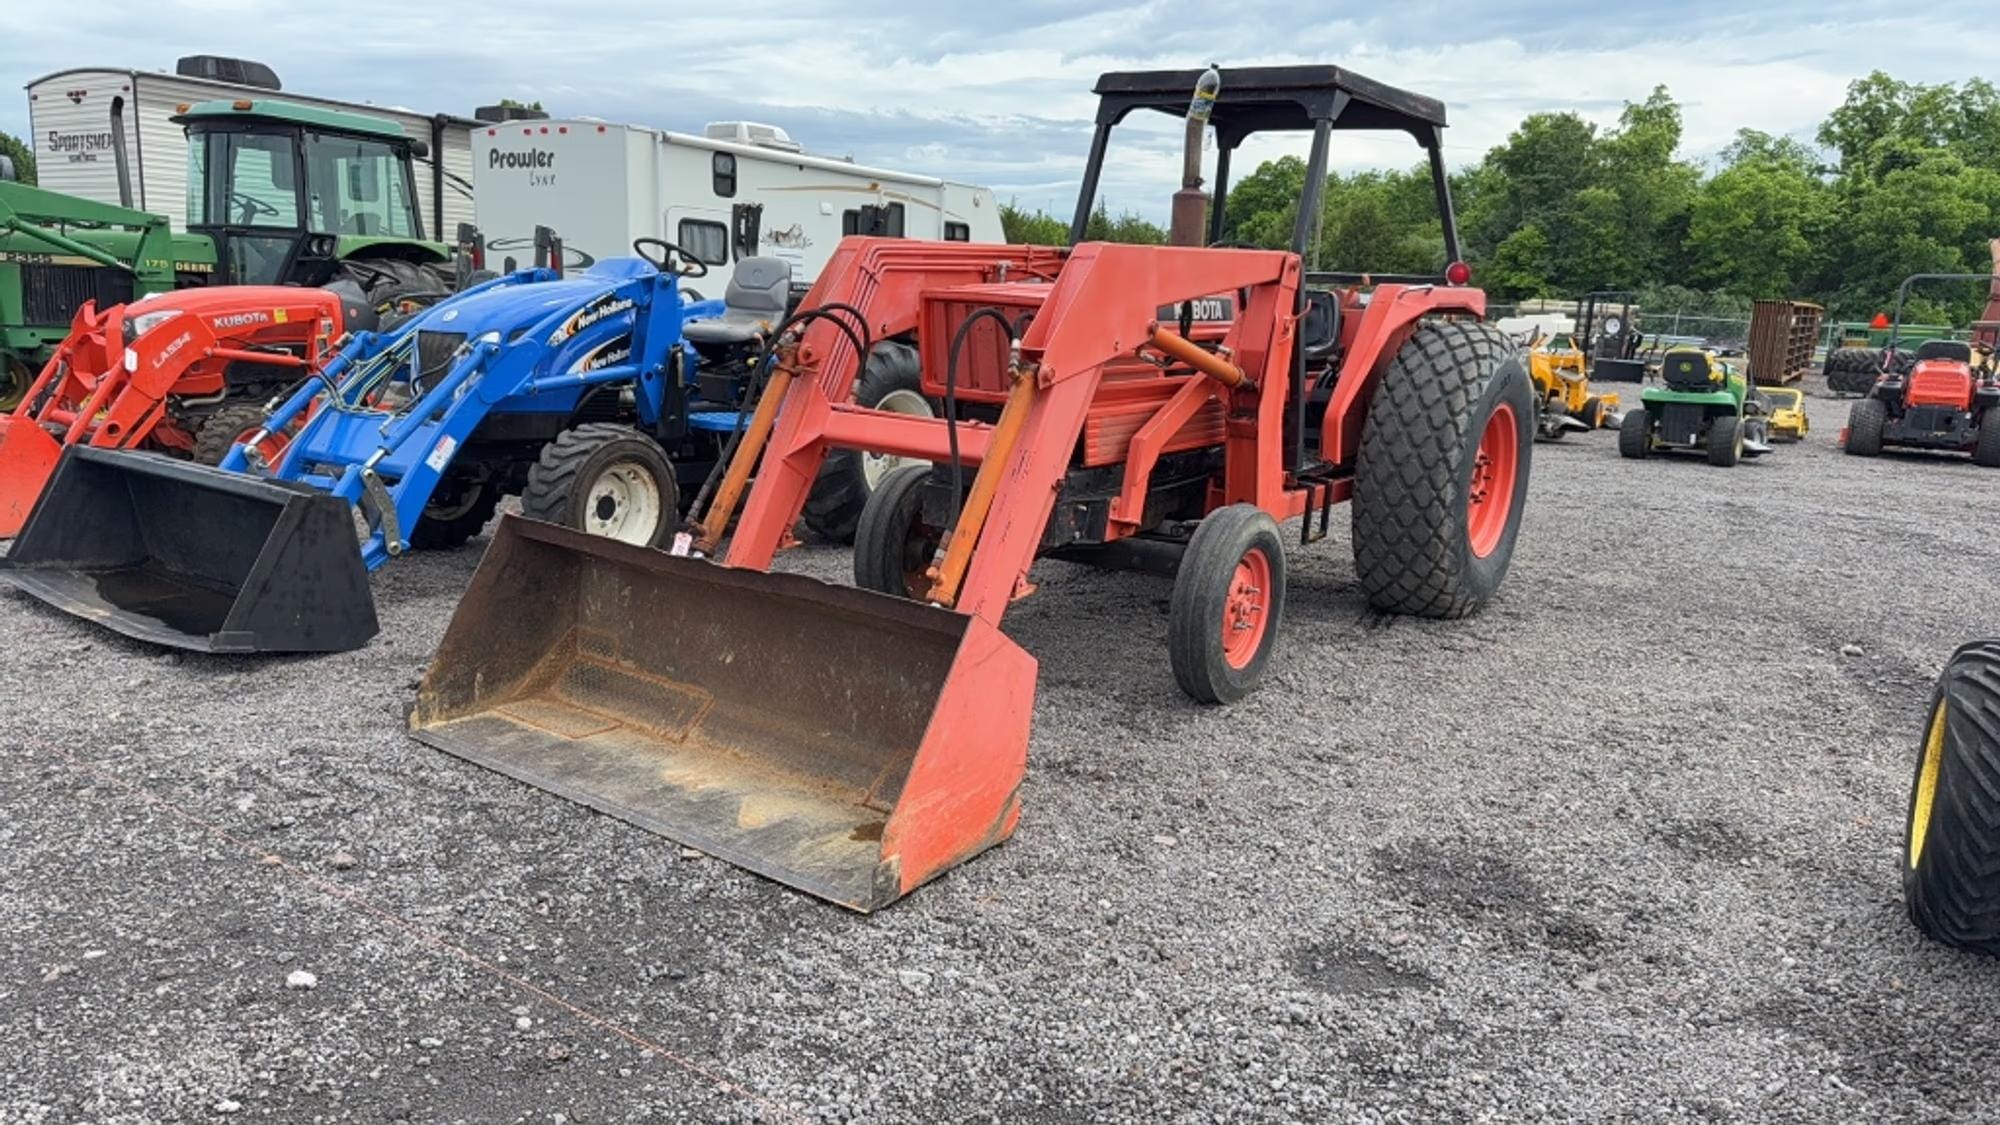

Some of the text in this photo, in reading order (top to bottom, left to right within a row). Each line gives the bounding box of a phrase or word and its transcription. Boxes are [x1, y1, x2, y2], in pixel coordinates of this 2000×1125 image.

[489, 148, 554, 168] Prowler
[175, 262, 214, 273] DEERE
[577, 298, 633, 330] New Holland
[1173, 300, 1223, 319] KBOTA
[213, 311, 269, 328] KUBOTA
